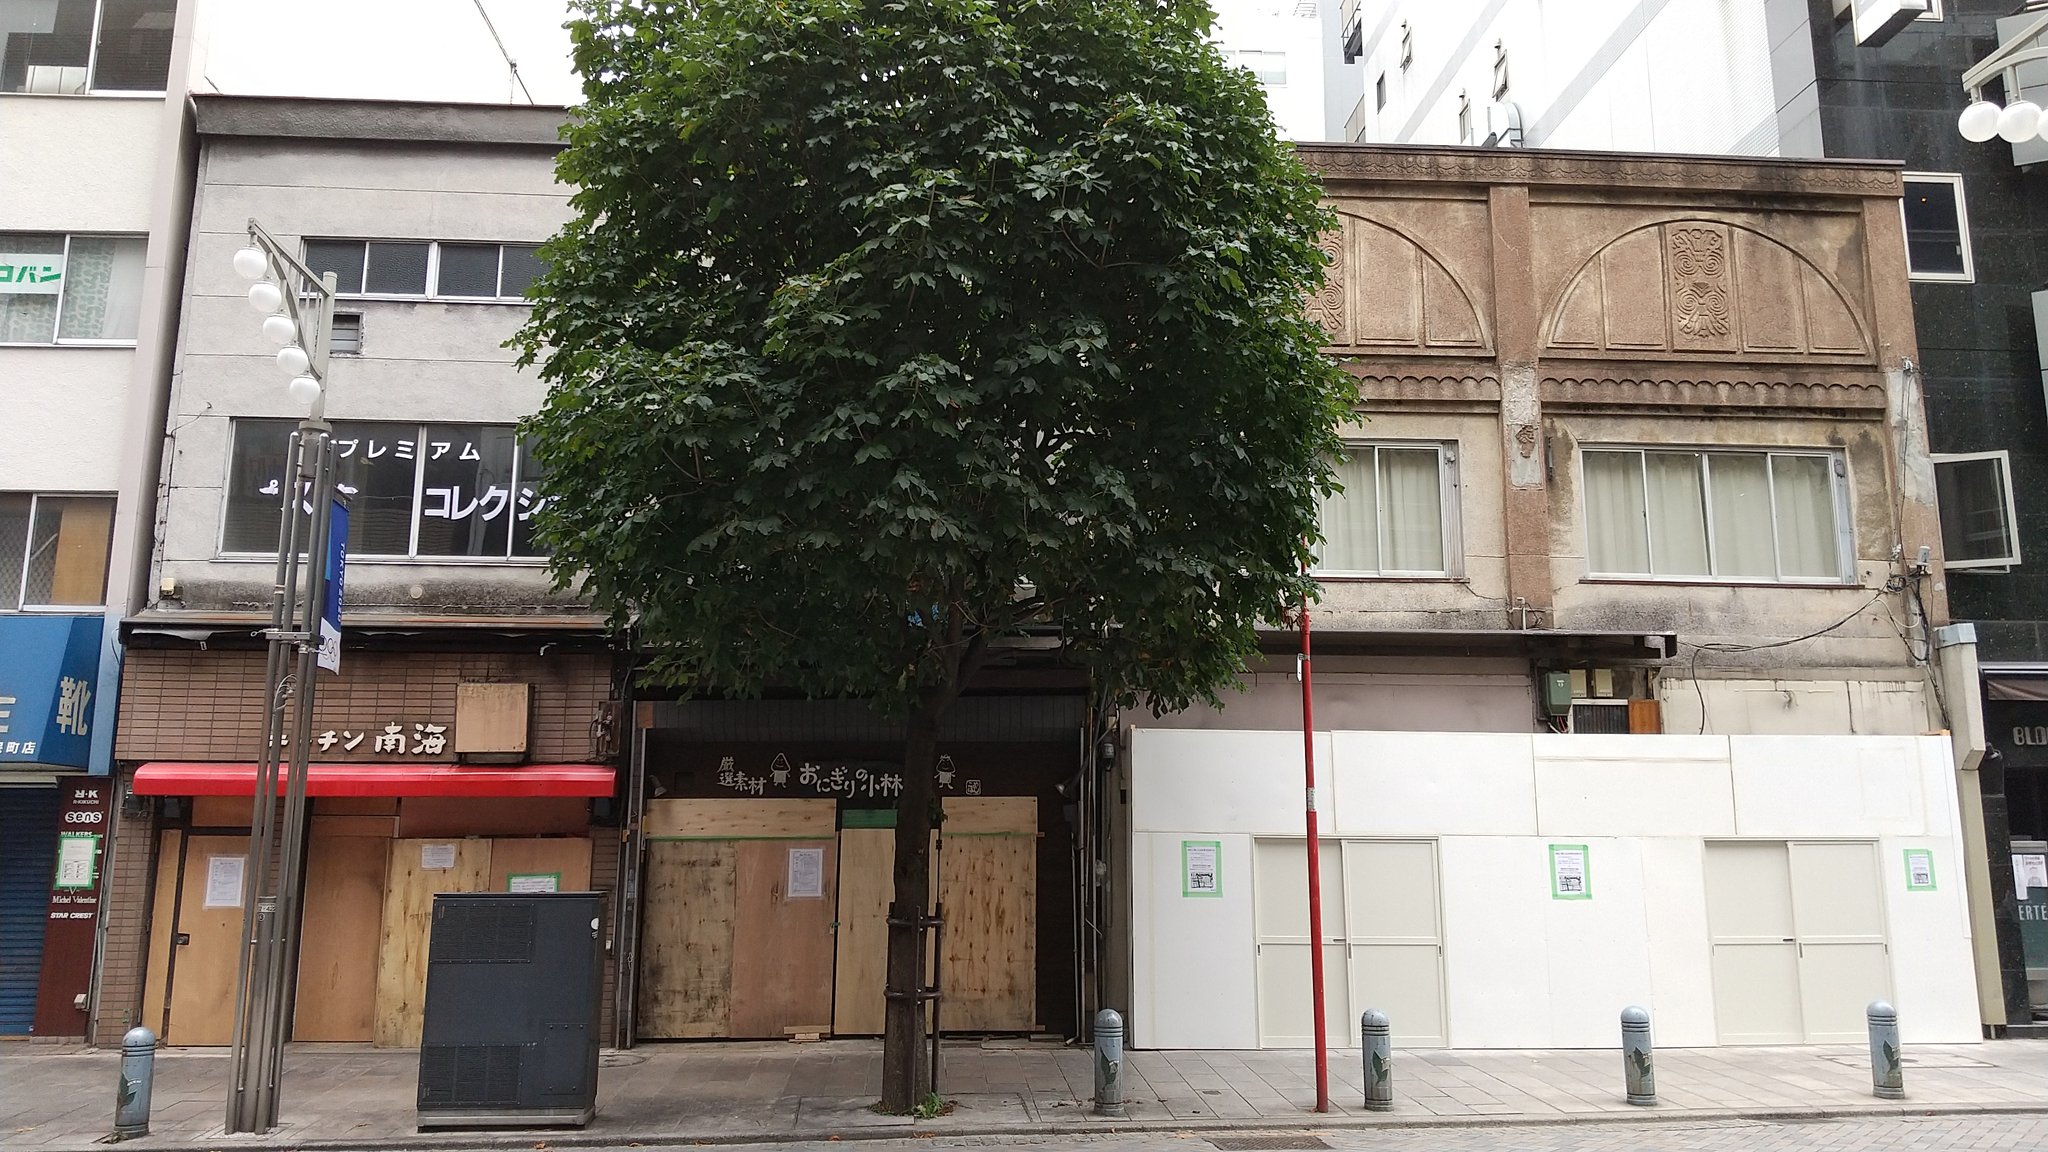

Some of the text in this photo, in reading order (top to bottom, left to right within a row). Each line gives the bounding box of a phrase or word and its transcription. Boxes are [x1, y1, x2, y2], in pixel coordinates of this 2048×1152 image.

[337, 438, 481, 461] プレミアム
[337, 543, 346, 585] TOKYO
[56, 676, 91, 736] 靴
[799, 762, 904, 798] おにぎりの小林
[64, 811, 102, 823] sens
